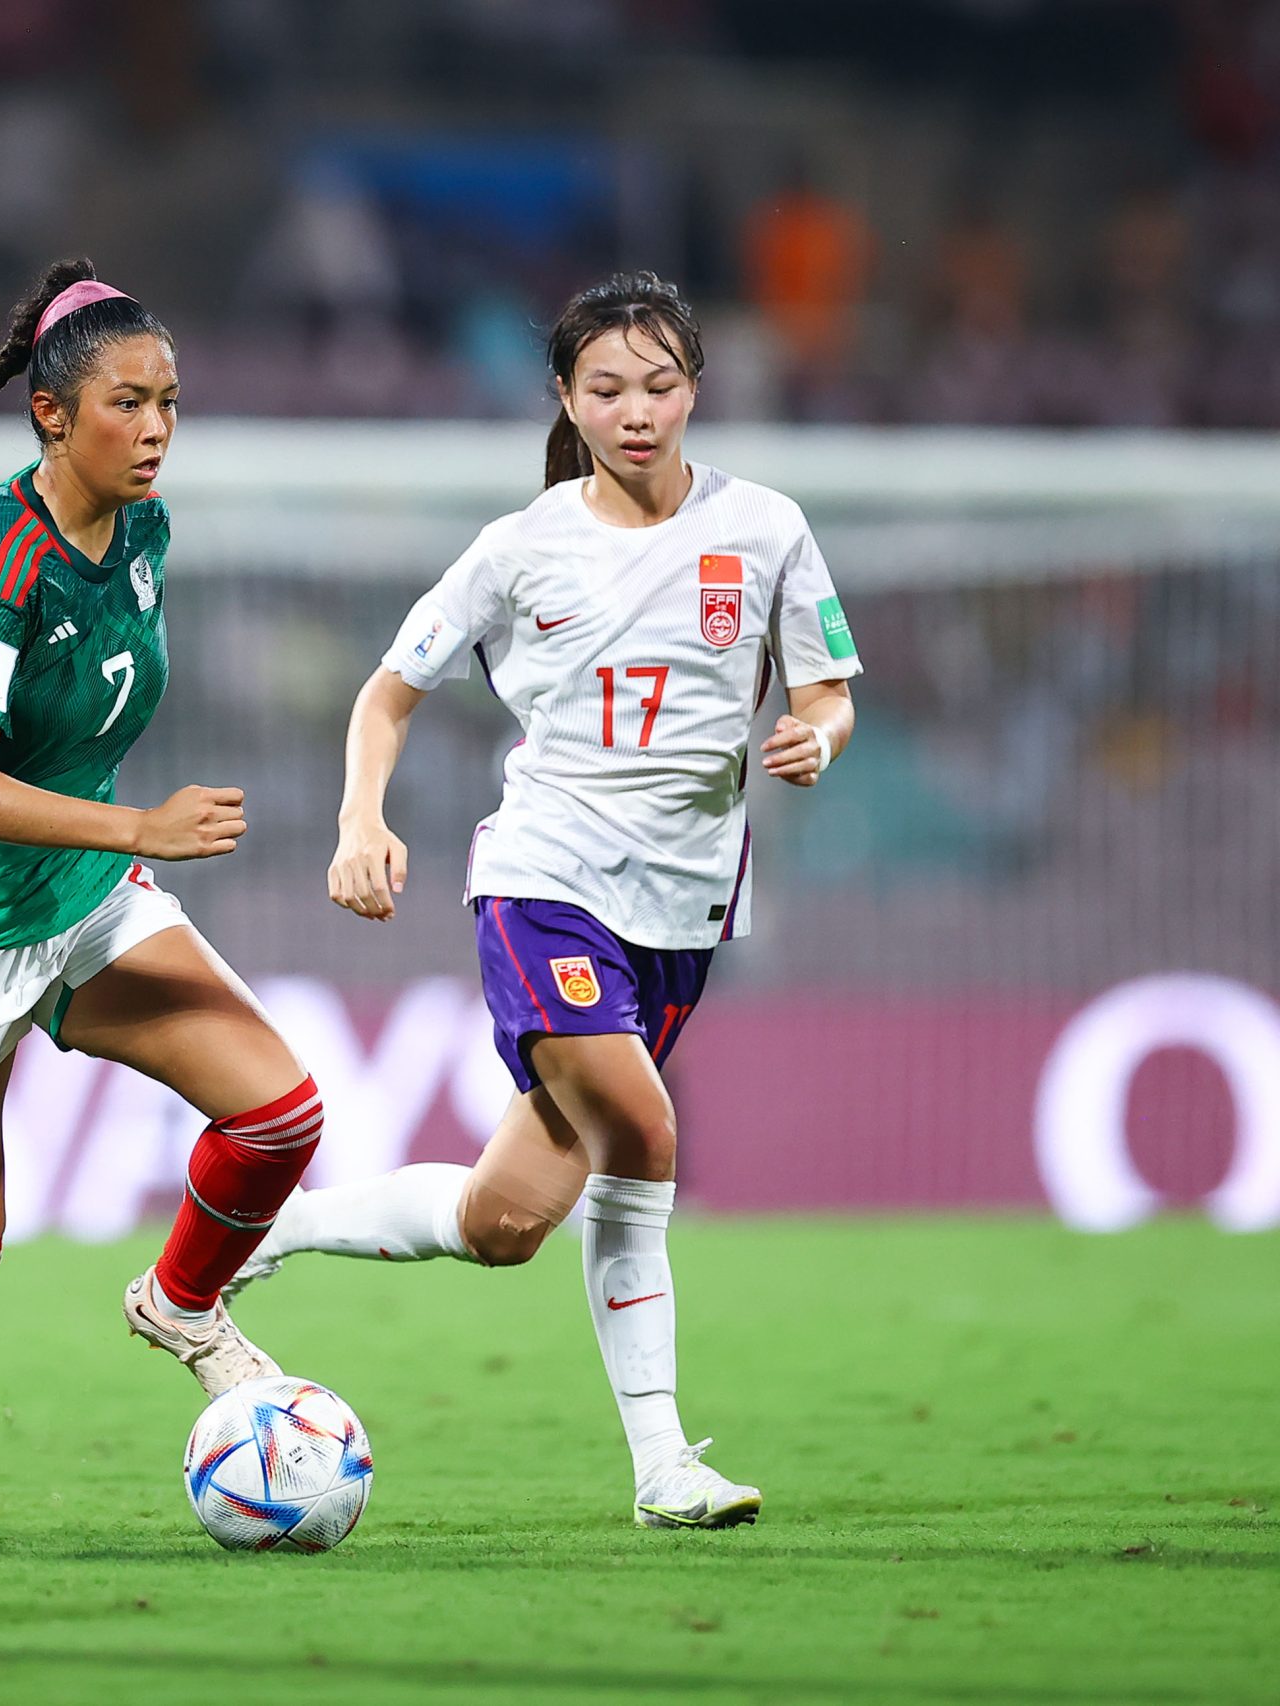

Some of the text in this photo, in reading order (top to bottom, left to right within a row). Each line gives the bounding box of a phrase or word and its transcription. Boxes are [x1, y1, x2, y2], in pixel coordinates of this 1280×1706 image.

[706, 595, 736, 605] CFA
[95, 650, 135, 737] 7
[596, 666, 669, 748] 17
[558, 963, 587, 972] CFA
